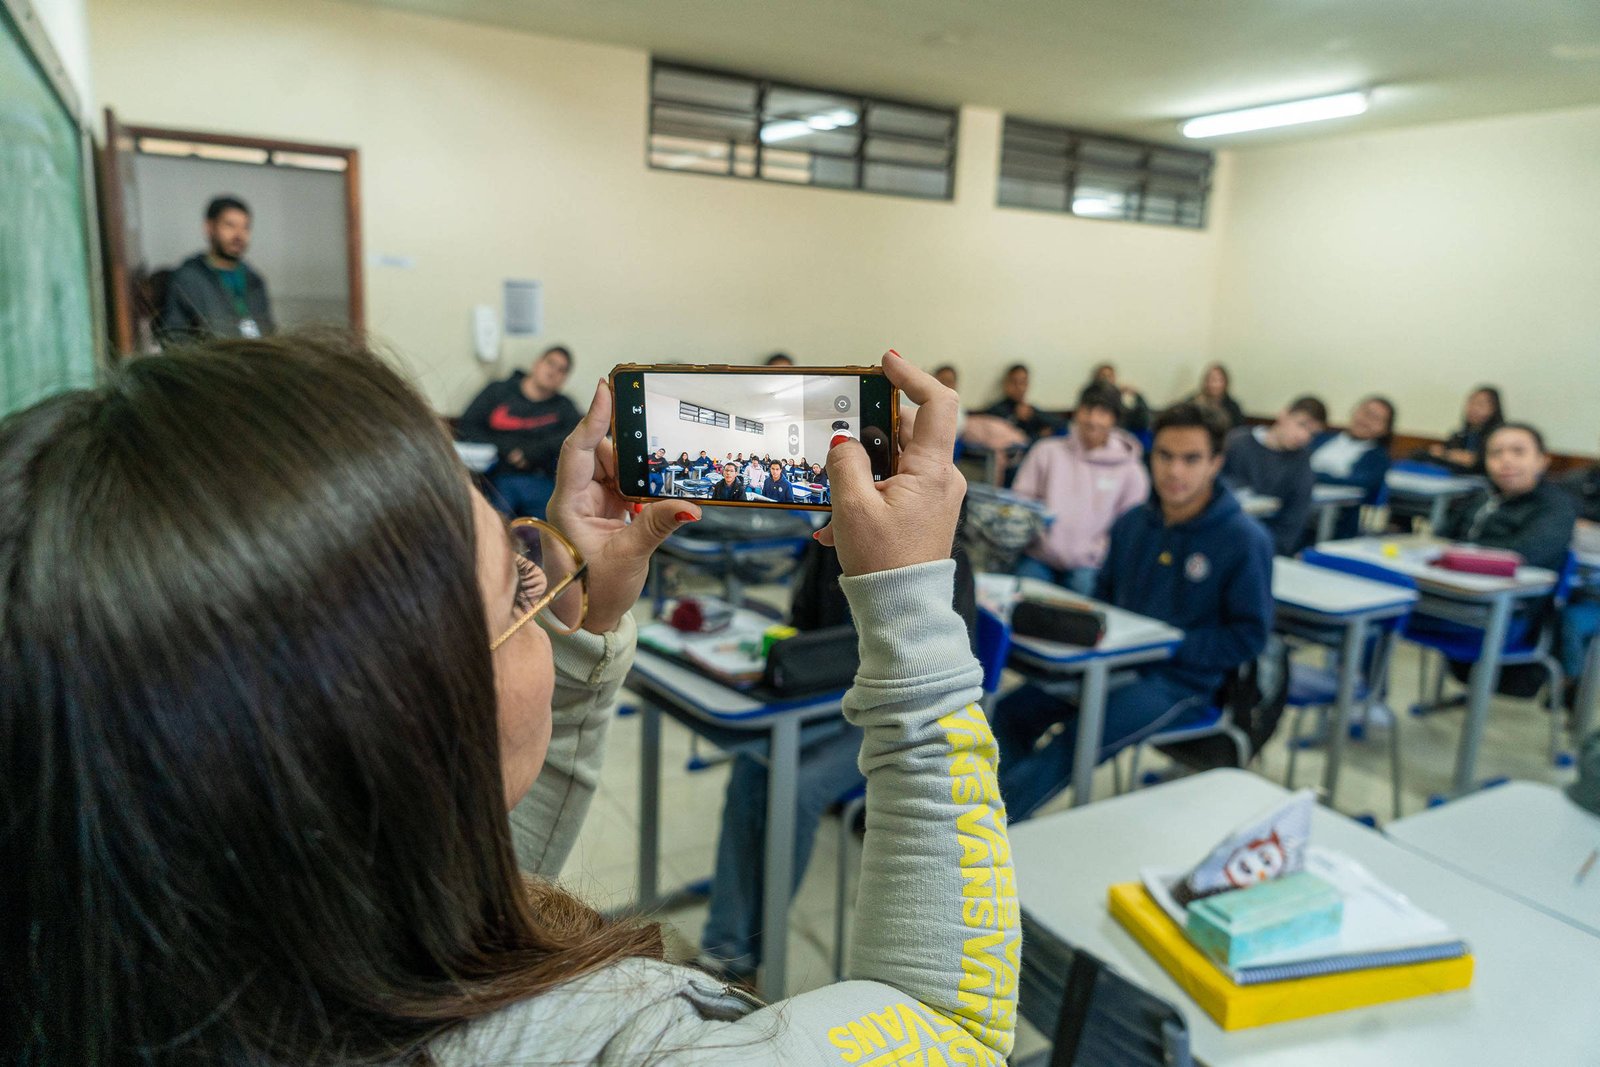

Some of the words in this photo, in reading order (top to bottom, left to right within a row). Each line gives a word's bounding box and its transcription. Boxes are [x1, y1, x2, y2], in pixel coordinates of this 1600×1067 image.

[956, 804, 1005, 931] VANS
[957, 931, 1005, 1026] VAN
[827, 1003, 941, 1067] VANS
